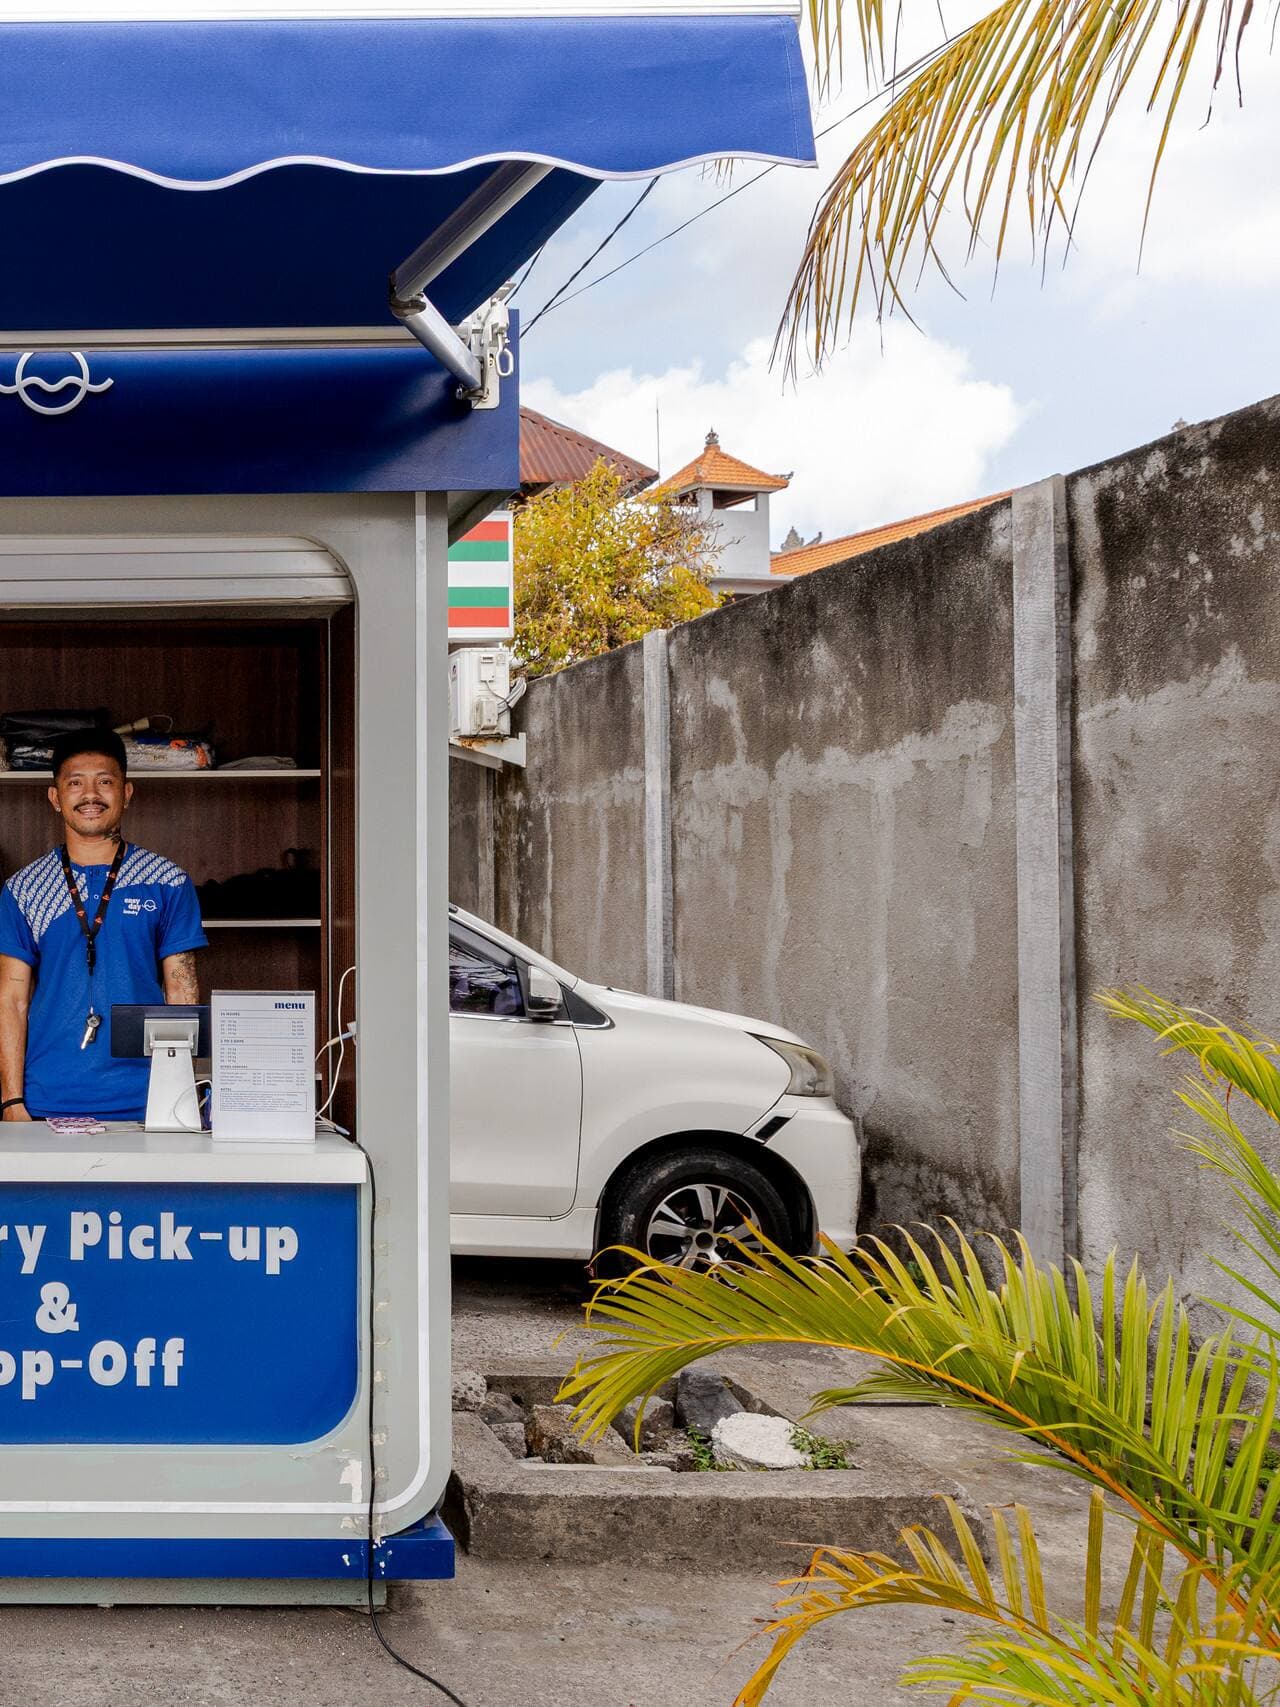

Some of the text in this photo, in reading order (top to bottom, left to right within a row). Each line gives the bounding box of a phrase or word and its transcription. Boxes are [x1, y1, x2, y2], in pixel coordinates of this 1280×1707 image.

[274, 1002, 306, 1010] menu
[70, 1211, 299, 1275] Pick-up
[35, 1281, 80, 1334] &
